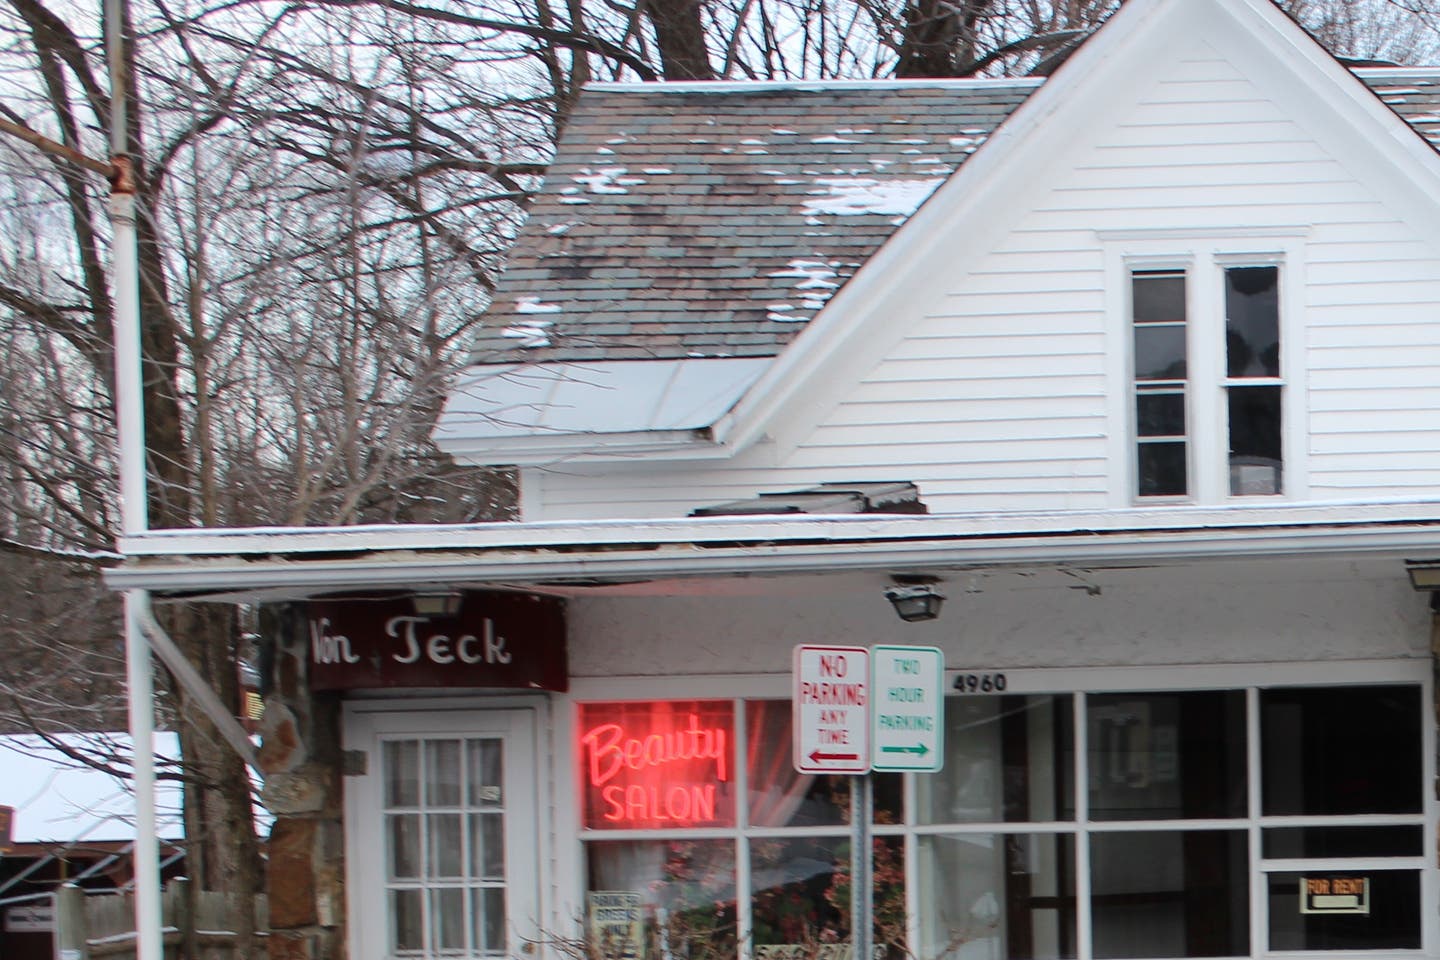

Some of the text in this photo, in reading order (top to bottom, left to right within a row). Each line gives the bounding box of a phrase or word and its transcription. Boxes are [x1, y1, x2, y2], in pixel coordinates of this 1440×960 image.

[310, 615, 512, 665] Von Teck
[820, 655, 847, 678] NO
[893, 658, 921, 675] TWO
[953, 674, 1007, 692] 4960
[801, 682, 866, 706] PARKING
[887, 687, 925, 703] HOUR
[820, 710, 848, 725] ANY
[880, 714, 933, 731] PARKING
[818, 728, 849, 744] TIME
[581, 713, 727, 786] Beauty
[602, 784, 716, 822] SALON
[1307, 879, 1364, 894] FOR RENT
